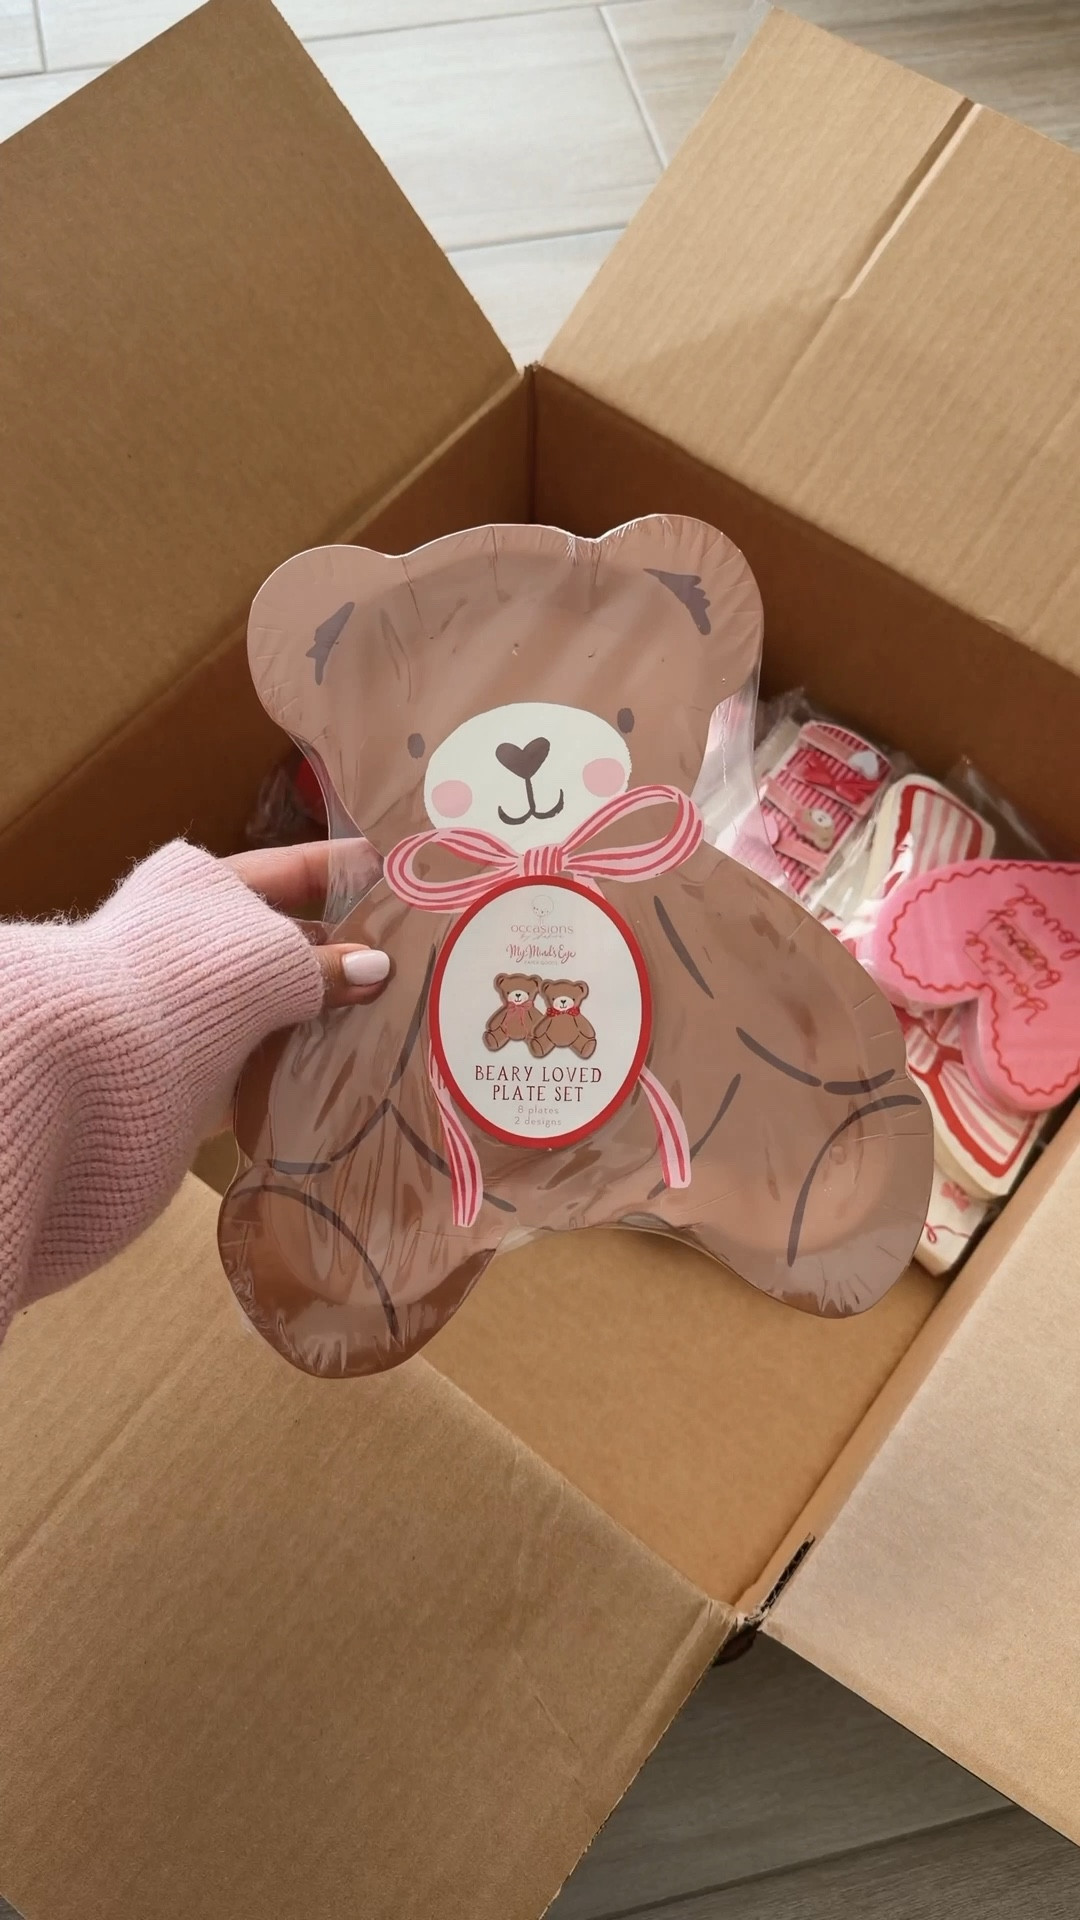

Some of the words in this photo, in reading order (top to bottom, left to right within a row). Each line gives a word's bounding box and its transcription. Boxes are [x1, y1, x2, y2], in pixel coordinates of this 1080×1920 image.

[1004, 882, 1080, 961] loved
[506, 944, 525, 963] My
[558, 944, 577, 964] Eye
[475, 1065, 533, 1082] BEARY
[542, 1066, 602, 1083] LOVED
[493, 1085, 547, 1101] PLATE
[554, 1086, 584, 1102] SET
[517, 1105, 524, 1113] 8
[528, 1105, 560, 1117] plates
[514, 1117, 521, 1125] 2
[524, 1117, 562, 1128] designs
